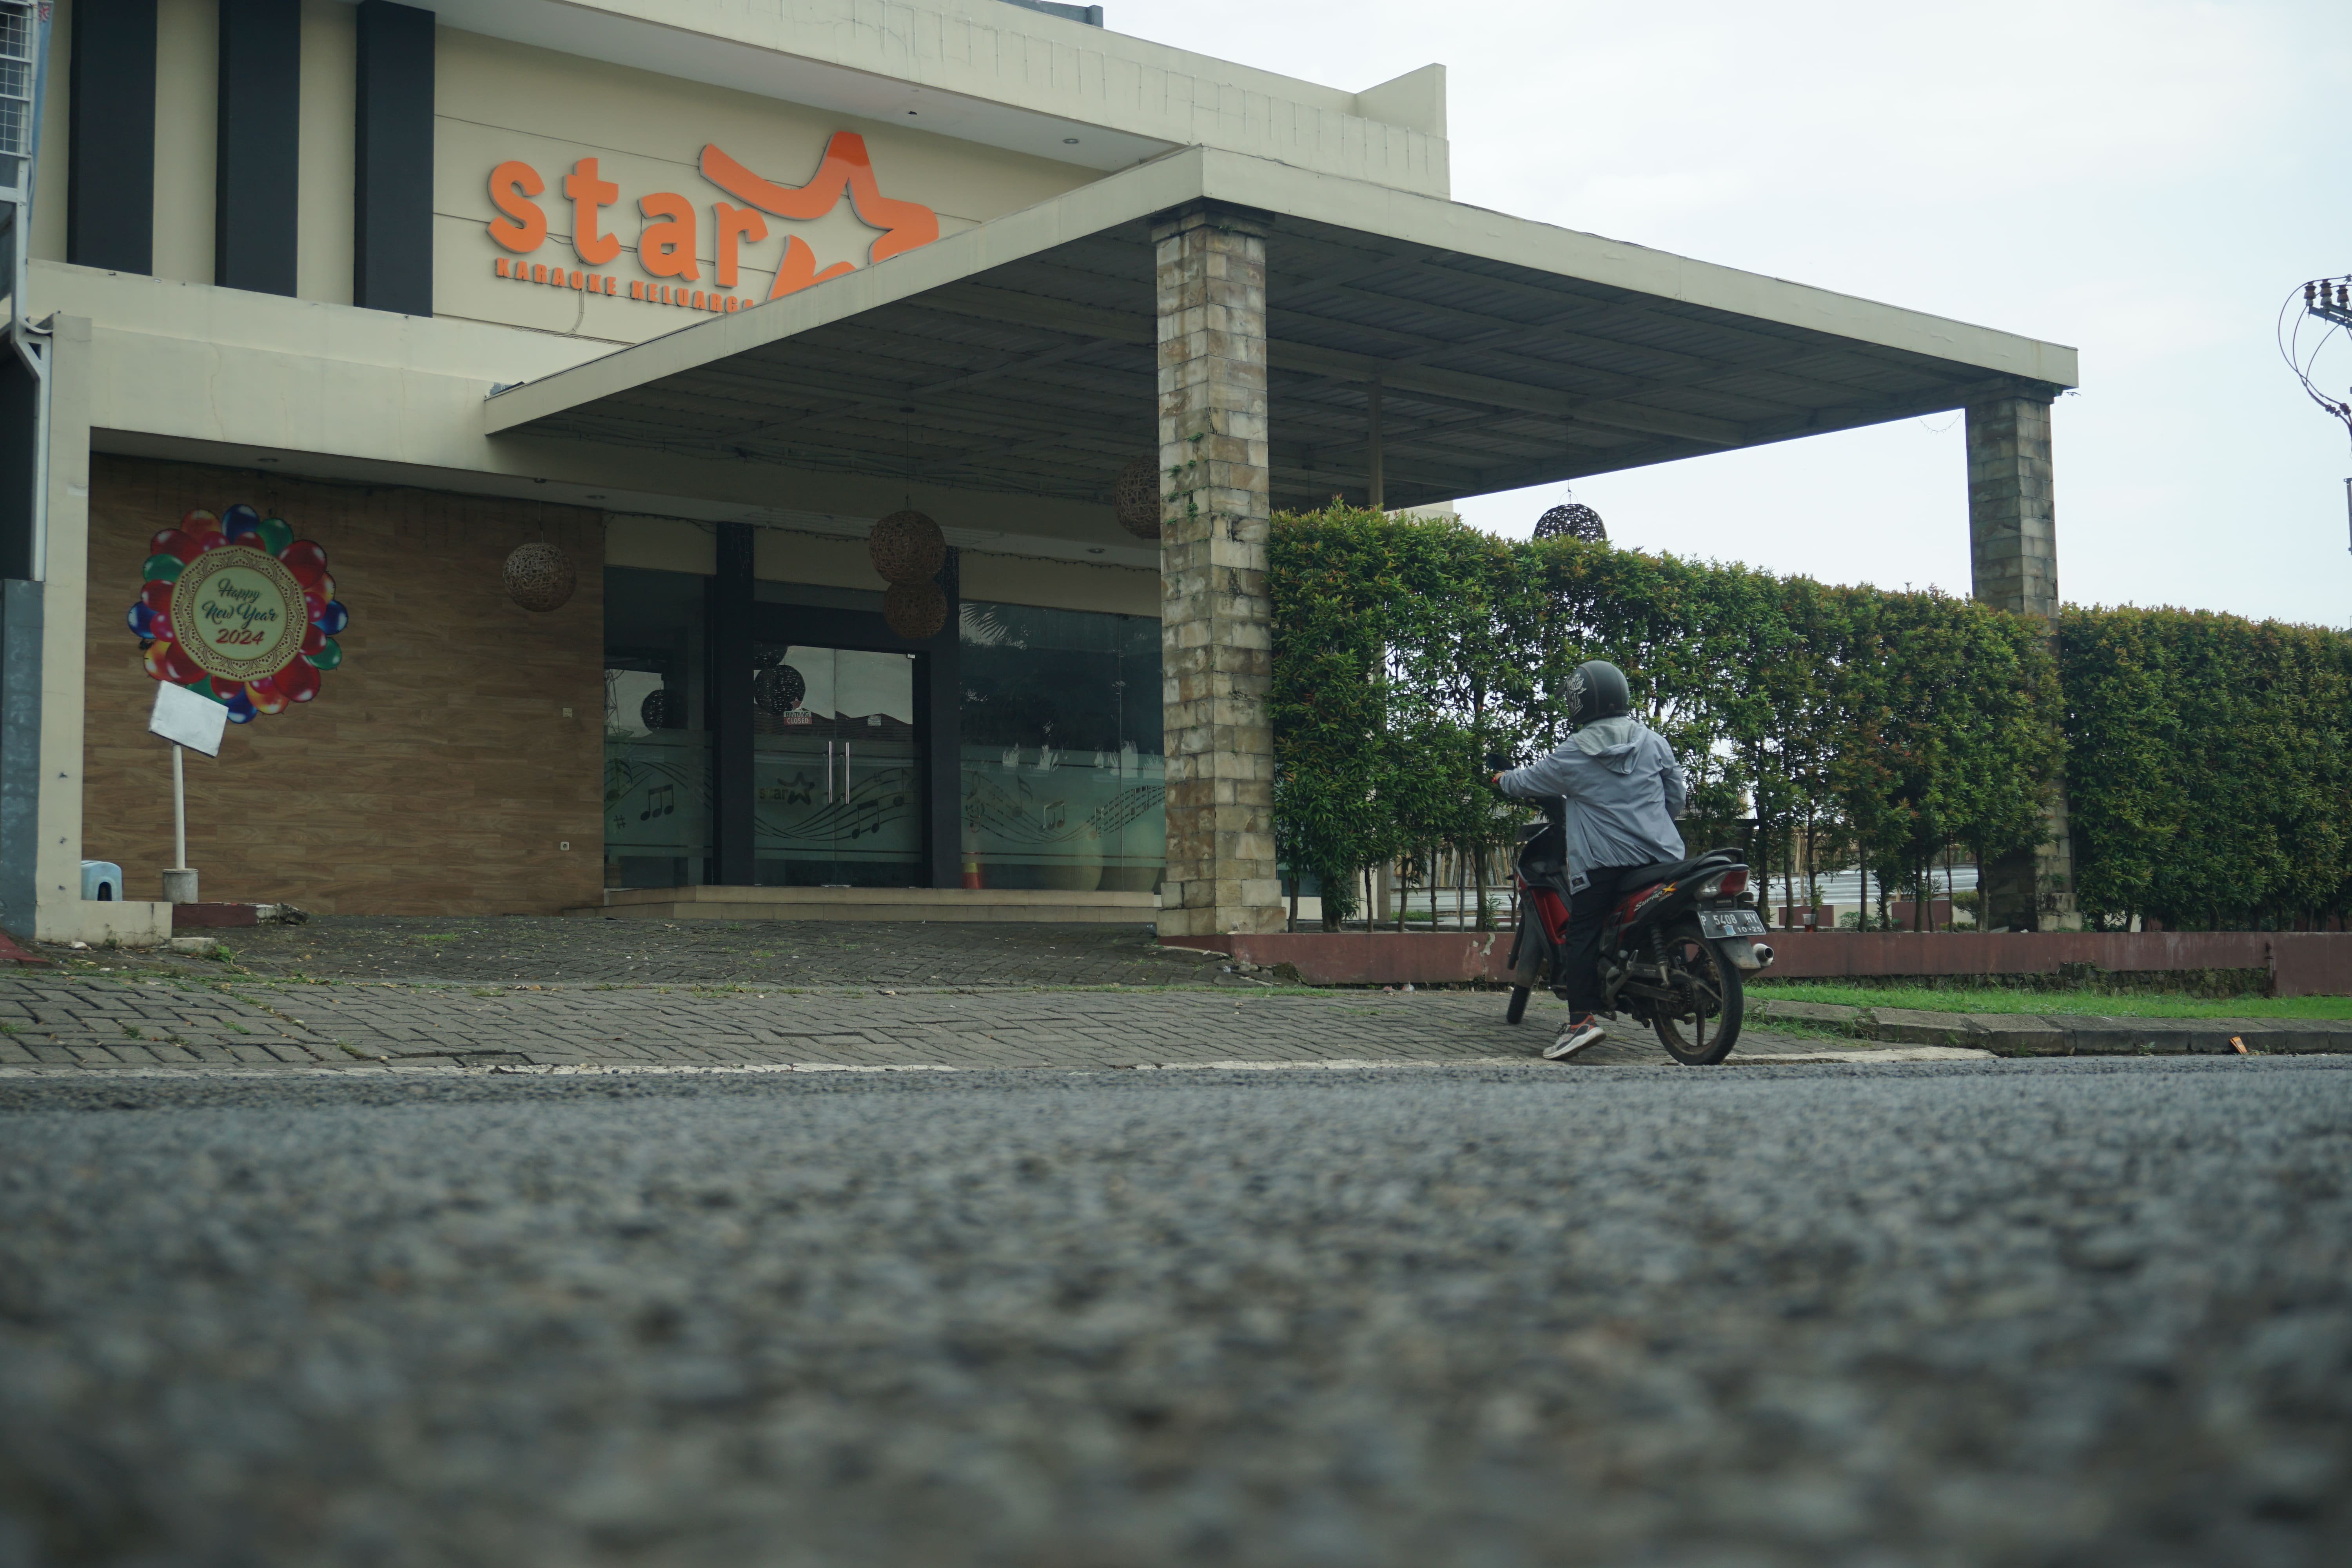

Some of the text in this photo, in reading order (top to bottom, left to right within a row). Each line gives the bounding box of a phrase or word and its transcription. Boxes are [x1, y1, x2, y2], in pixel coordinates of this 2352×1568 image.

[487, 157, 769, 288] star
[496, 258, 617, 295] KARAOKE
[218, 578, 261, 603] Happy
[202, 601, 277, 628] New Year
[216, 628, 264, 645] 2024
[1700, 913, 1757, 926] P 5408 HY
